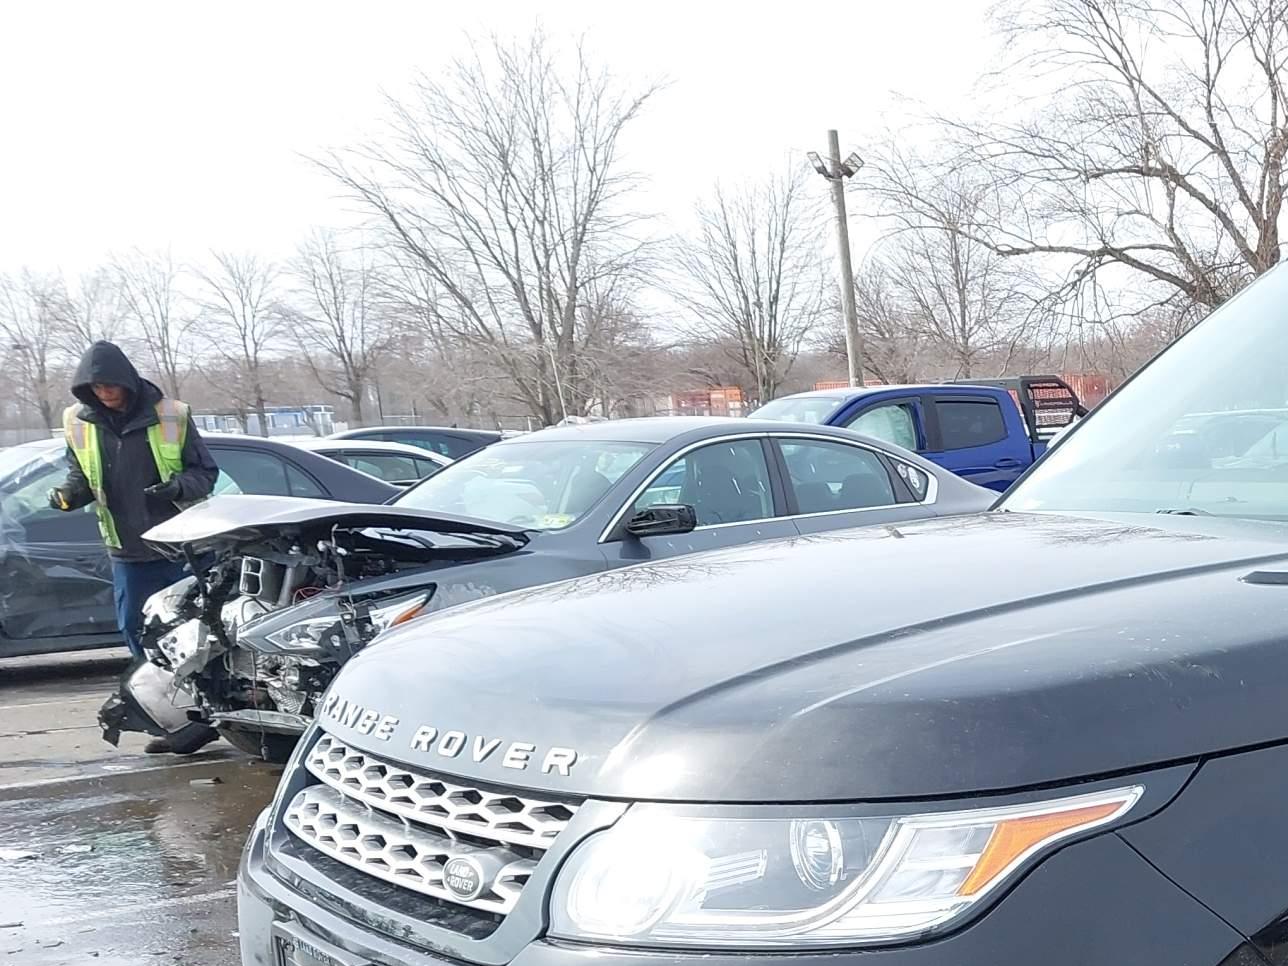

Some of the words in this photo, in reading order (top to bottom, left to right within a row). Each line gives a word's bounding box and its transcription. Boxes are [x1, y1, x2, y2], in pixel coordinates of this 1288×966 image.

[322, 692, 400, 742] RANGE
[409, 724, 579, 777] ROVER
[450, 875, 474, 892] ROVER
